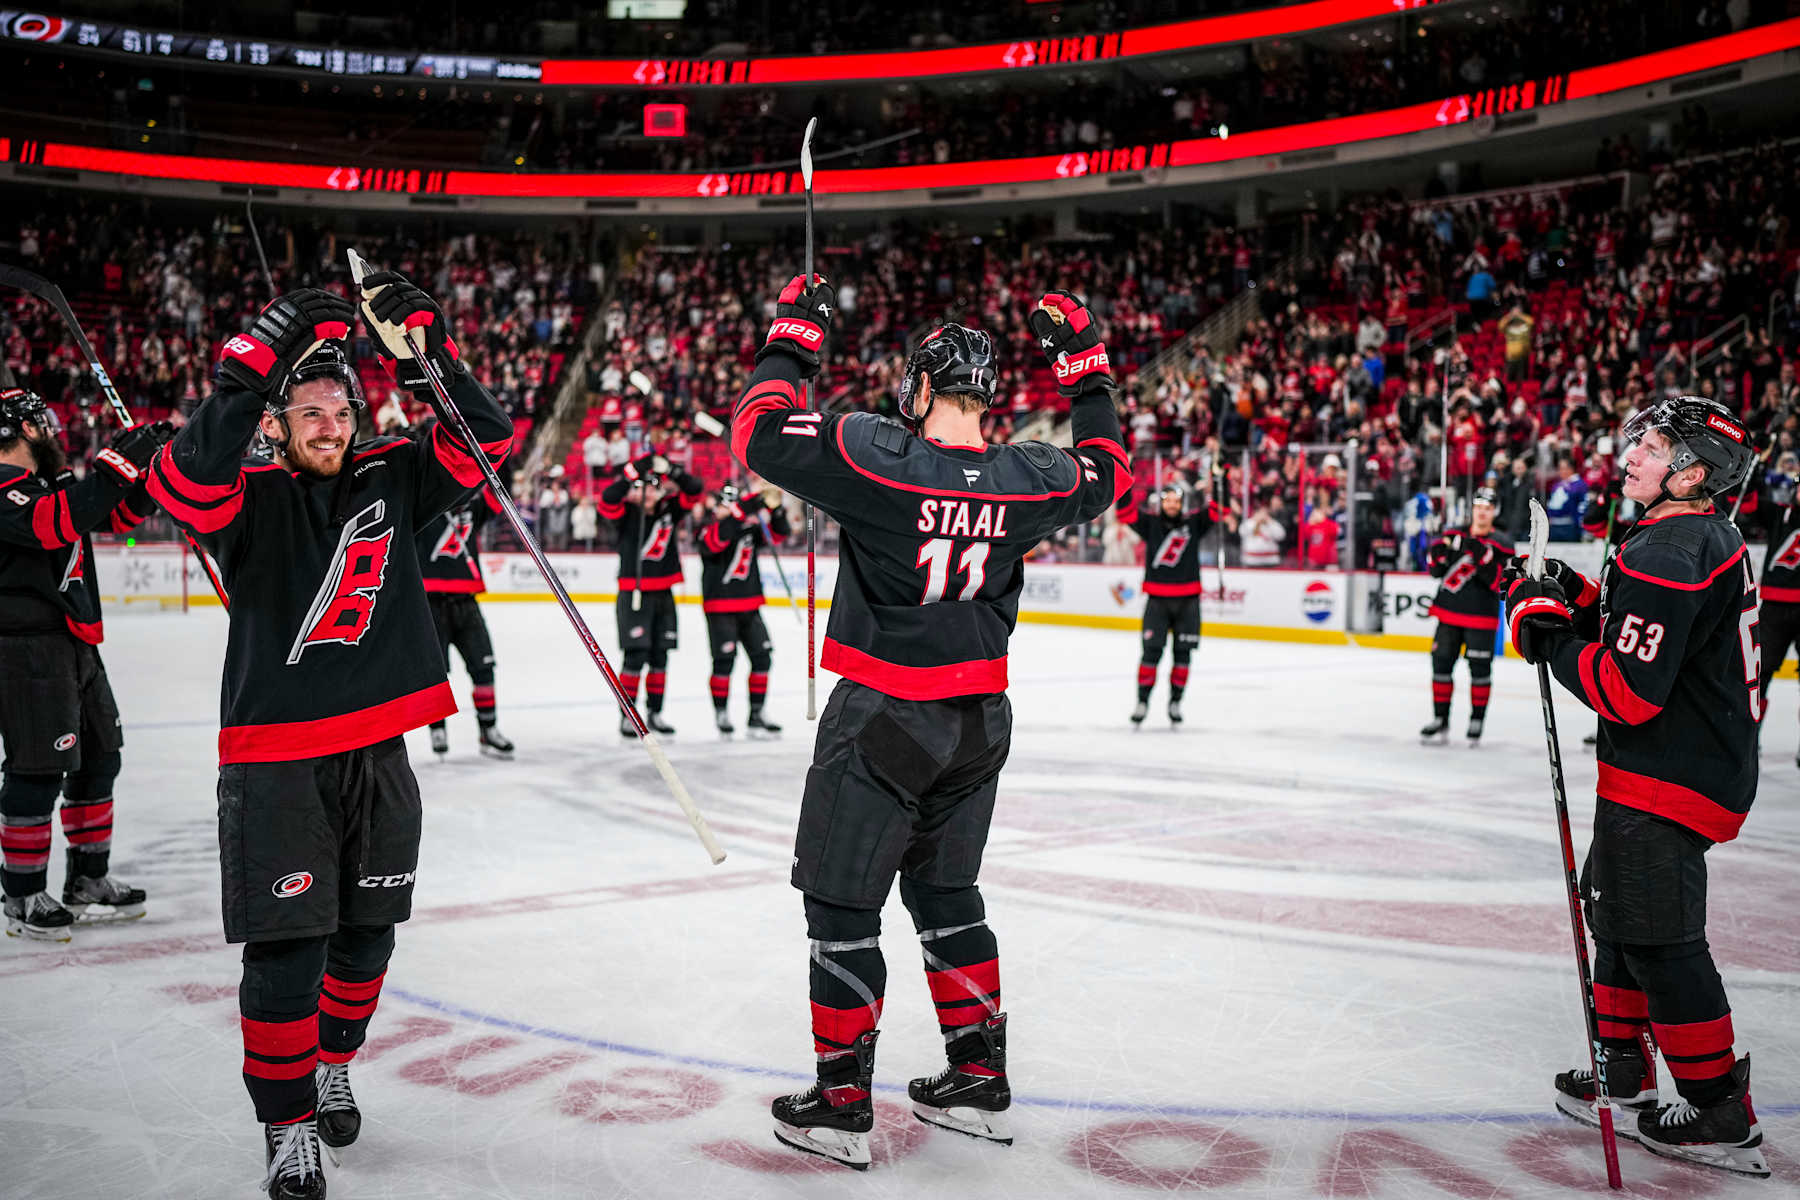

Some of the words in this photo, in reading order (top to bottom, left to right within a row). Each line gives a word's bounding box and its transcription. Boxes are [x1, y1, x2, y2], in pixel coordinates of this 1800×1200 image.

[971, 367, 984, 386] 11
[92, 362, 135, 428] CCM
[781, 411, 823, 437] 11
[1710, 416, 1742, 440] Lenovo
[6, 489, 31, 506] 8
[918, 499, 1008, 538] STAAL
[915, 538, 991, 606] 11
[1616, 613, 1665, 663] 53
[357, 870, 417, 888] CCM
[1593, 1040, 1609, 1098] CCM
